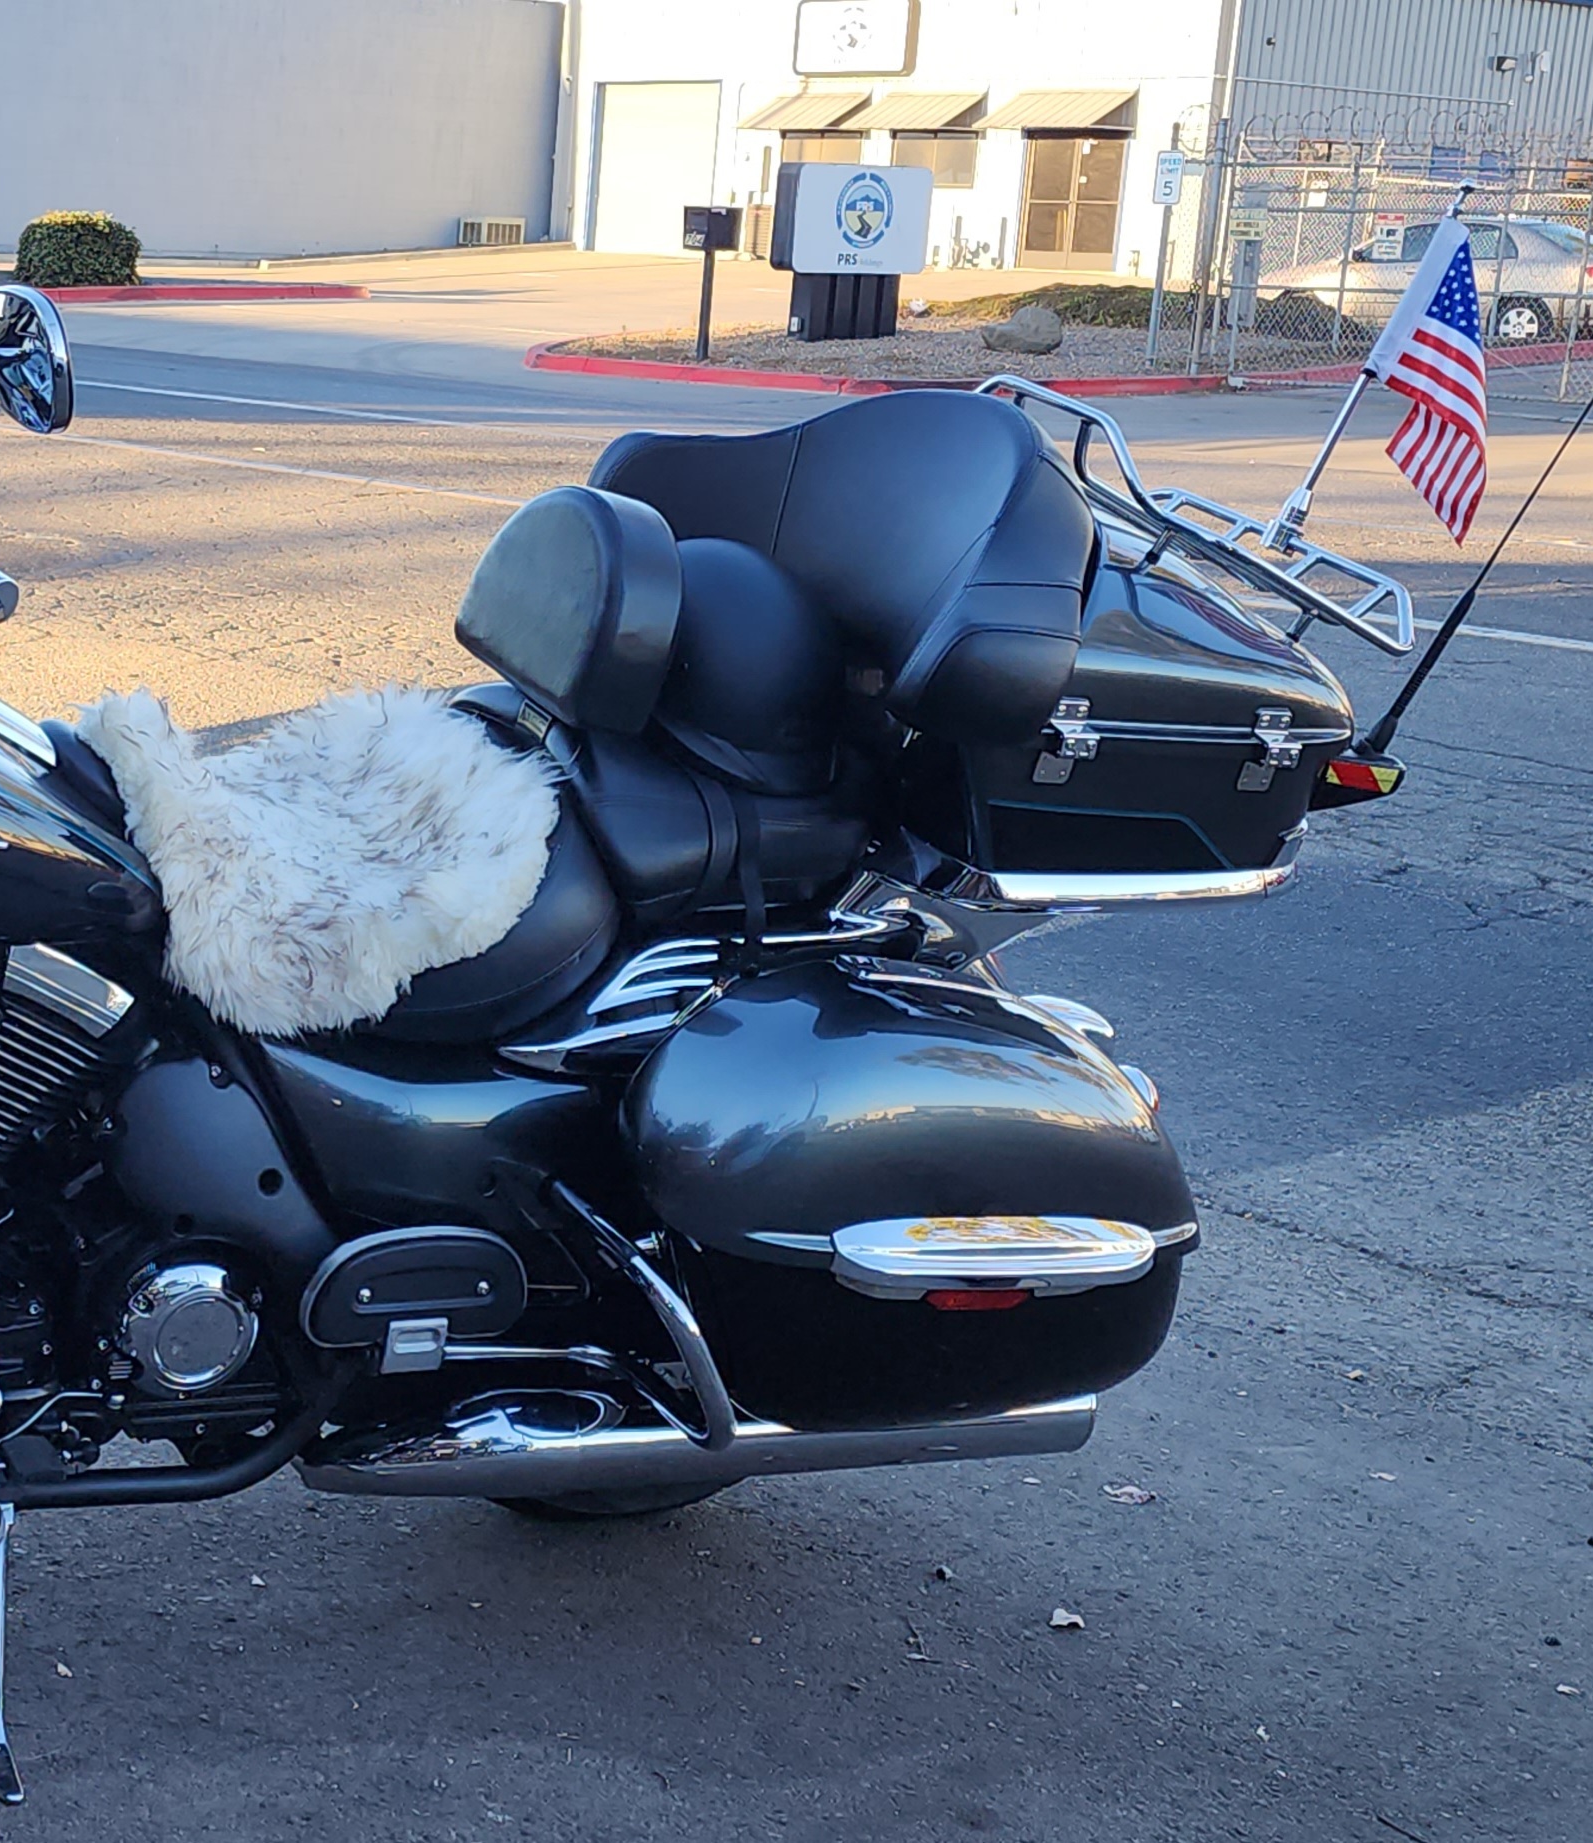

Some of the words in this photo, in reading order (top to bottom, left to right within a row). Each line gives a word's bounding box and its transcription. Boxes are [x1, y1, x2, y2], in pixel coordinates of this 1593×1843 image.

[1160, 167, 1180, 175] LIMIT
[1162, 180, 1173, 197] 5
[856, 200, 875, 211] PRS
[837, 253, 858, 266] PRS
